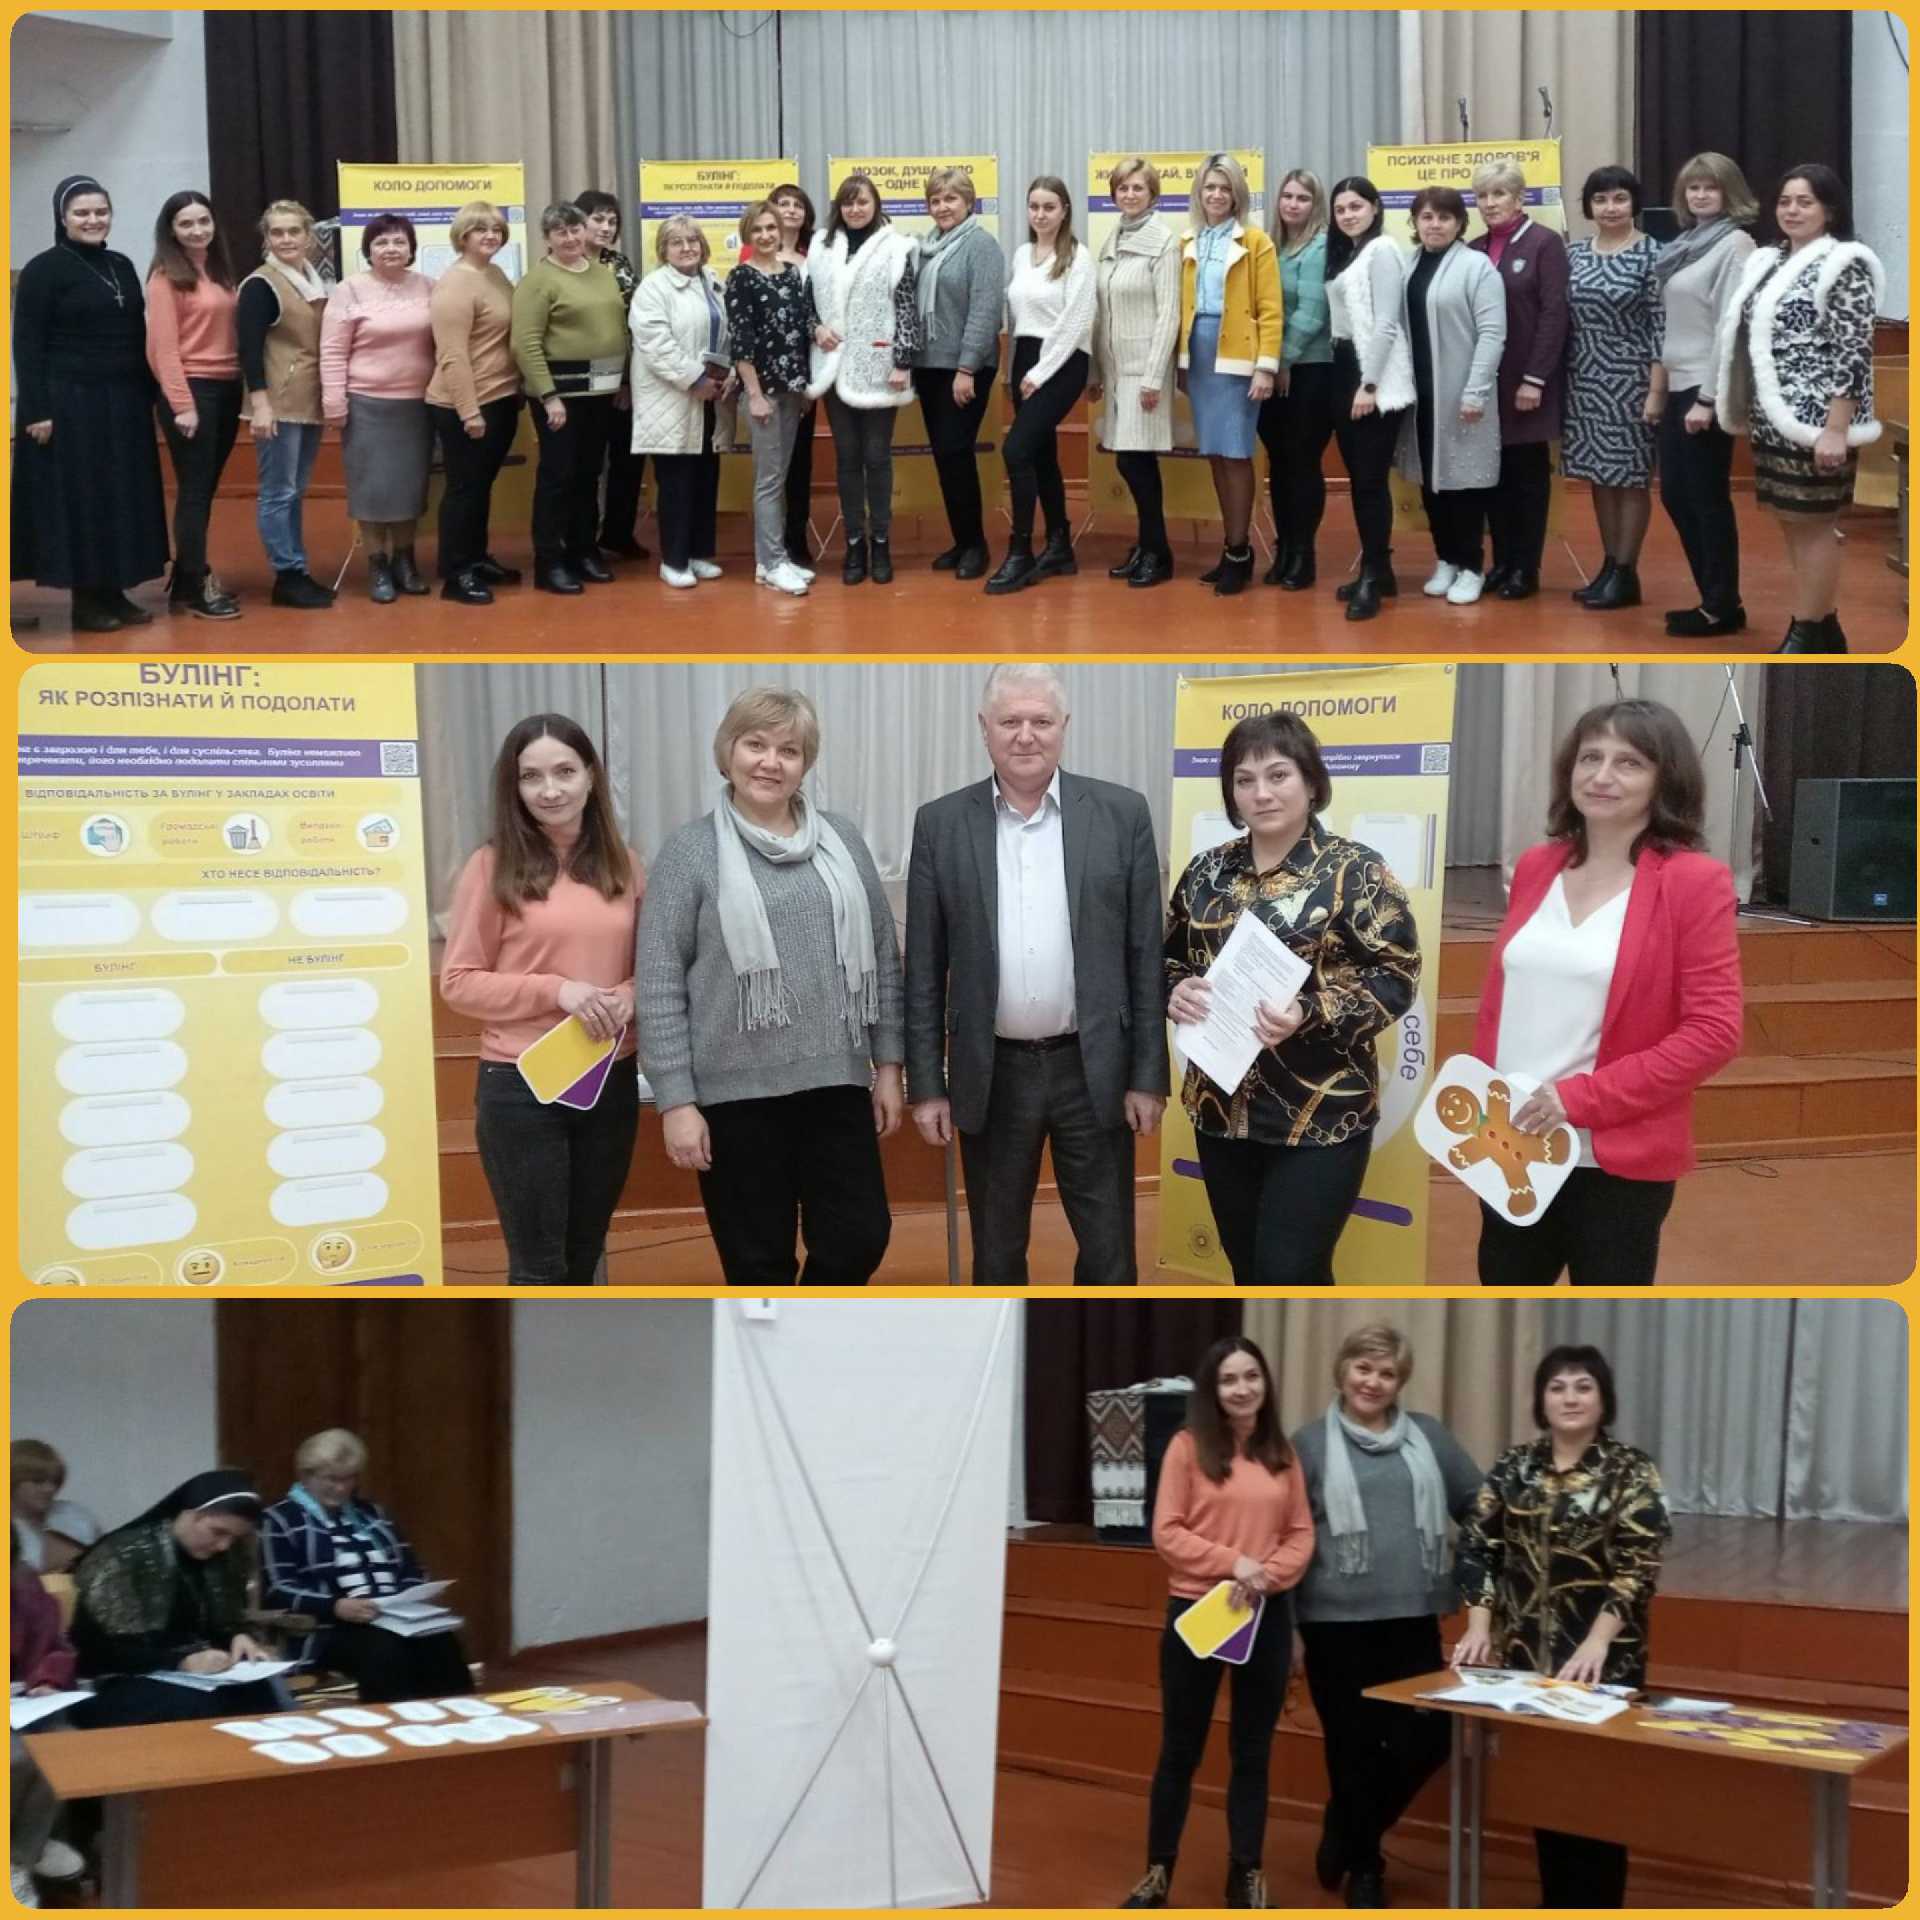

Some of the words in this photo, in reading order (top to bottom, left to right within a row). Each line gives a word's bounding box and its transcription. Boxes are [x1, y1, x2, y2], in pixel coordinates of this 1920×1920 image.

[1387, 154, 1461, 166] ПСИХІЧНЕ
[1417, 168, 1437, 181] ЦЕ
[1441, 167, 1471, 180] ПРО
[374, 180, 412, 191] КОЛО
[415, 179, 492, 192] ДОПОМОГИ
[885, 179, 920, 191] ОДНЕ
[139, 663, 260, 688] БУЛІНГ:
[39, 690, 69, 705] ЯК
[75, 690, 214, 709] РОЗПІЗНАТИ
[221, 691, 235, 709] Й
[241, 695, 356, 712] ПОДОЛАТИ
[1222, 702, 1274, 721] КОЛО
[24, 788, 149, 799] ВІДПОВІДАЛЬНІСТЬ
[153, 789, 168, 799] ЗА
[171, 789, 212, 799] БУЛІНГ
[215, 789, 223, 799] У
[227, 789, 290, 799] ЗАКЛАДАХ
[292, 789, 336, 798] ОСВІТИ
[202, 870, 226, 880] ХТО
[229, 870, 261, 880] НЕСЕ
[263, 866, 382, 879] ВІДПОВІДАЛЬНІСТЬ?
[1400, 1014, 1426, 1081] себе
